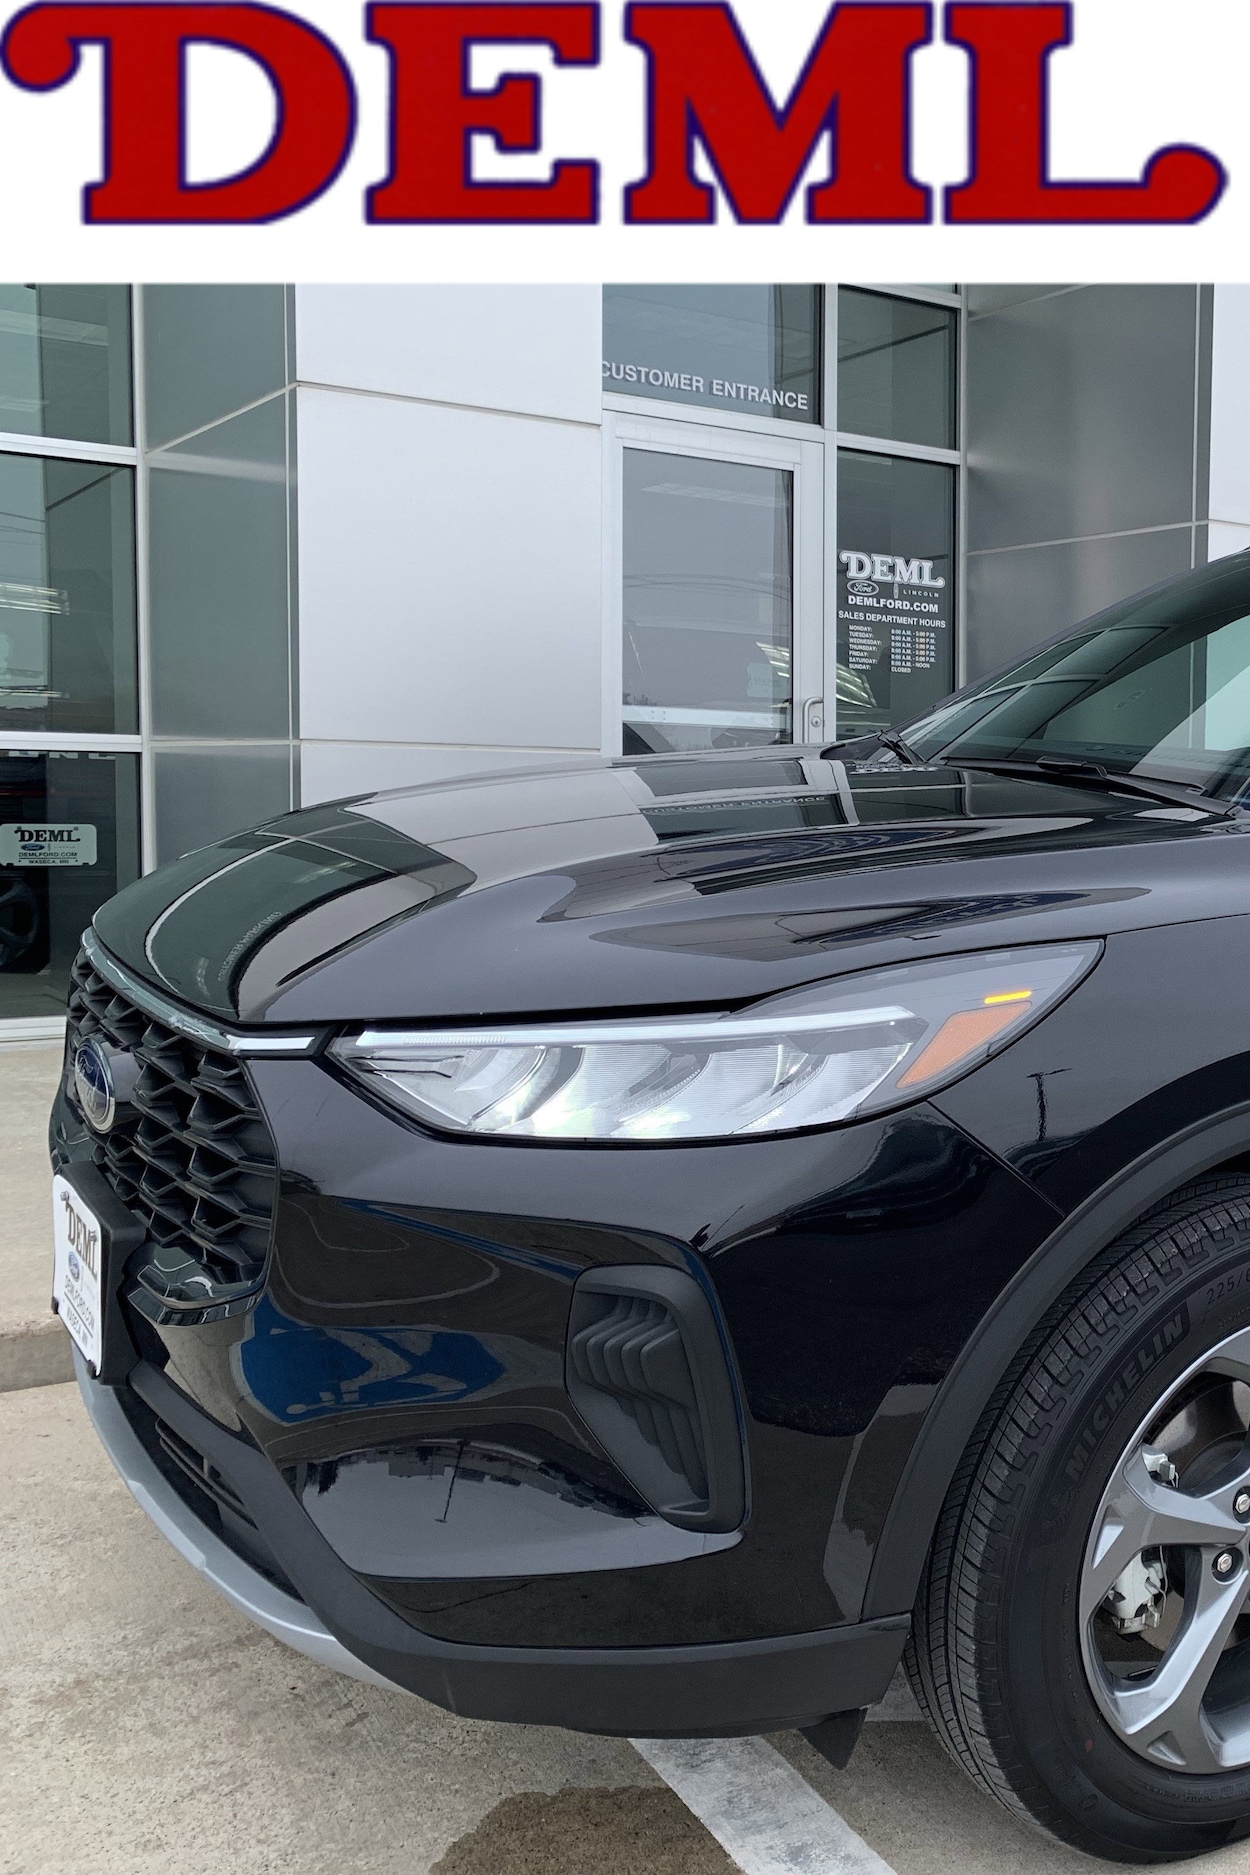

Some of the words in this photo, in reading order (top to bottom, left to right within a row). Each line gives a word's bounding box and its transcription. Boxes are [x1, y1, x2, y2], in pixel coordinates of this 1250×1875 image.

[601, 360, 704, 393] CUSTOMER
[712, 380, 809, 410] ENTRANCE
[839, 550, 946, 589] DEML
[853, 582, 873, 593] Ford
[903, 589, 939, 598] LINCOLN
[848, 595, 939, 613] DEMLFORD.COM
[838, 610, 865, 621] SALES
[866, 613, 918, 626] DEPARTMENT
[919, 618, 946, 629] HOURS
[14, 829, 81, 842] DEML
[65, 1202, 98, 1284] DEML
[1065, 1312, 1184, 1483] MICHELIN
